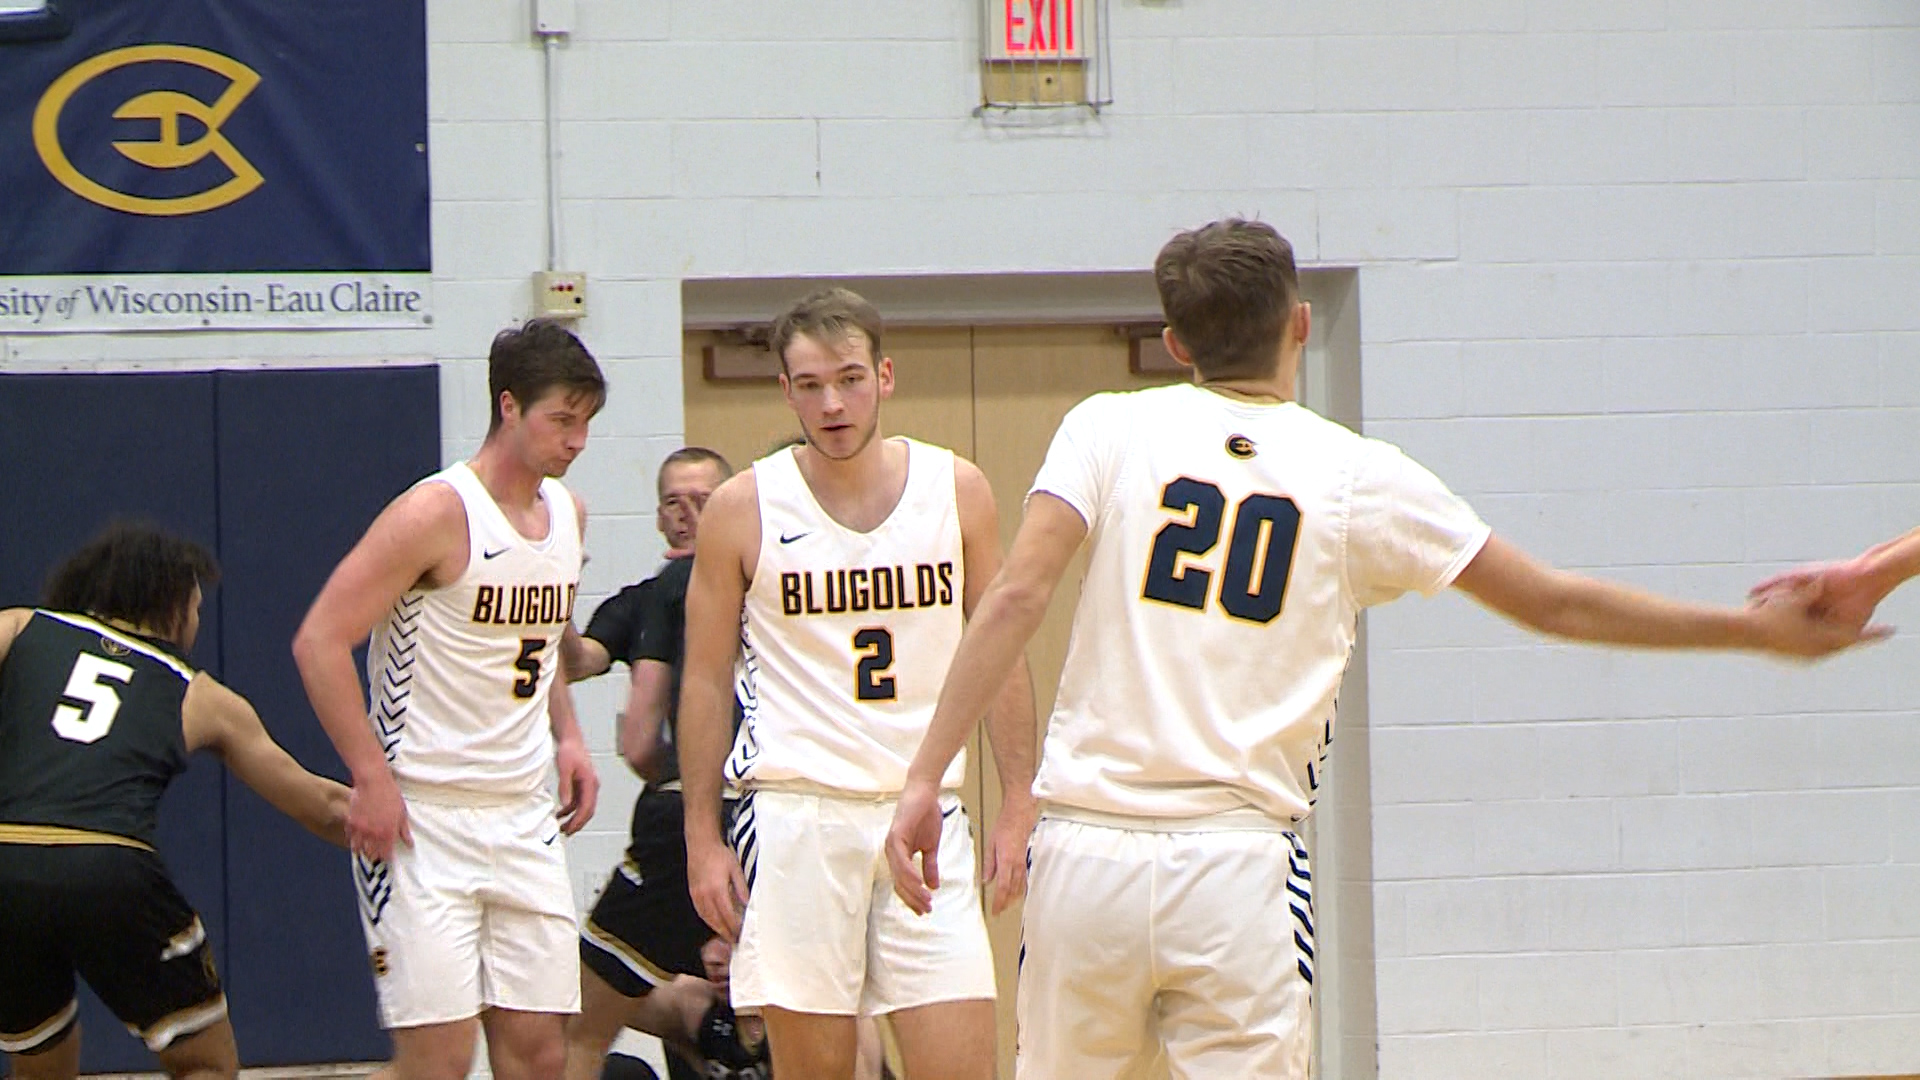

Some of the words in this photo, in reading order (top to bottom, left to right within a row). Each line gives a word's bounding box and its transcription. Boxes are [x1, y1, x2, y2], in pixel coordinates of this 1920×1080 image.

[1005, 0, 1075, 54] EXIT
[56, 289, 81, 320] of
[83, 283, 325, 314] Wisconsin-Eau
[329, 280, 422, 312] Claire
[1140, 473, 1304, 626] 20
[780, 560, 954, 616] BLUGOLDS
[512, 637, 547, 699] 5
[851, 625, 898, 702] 2
[51, 651, 134, 744] 5
